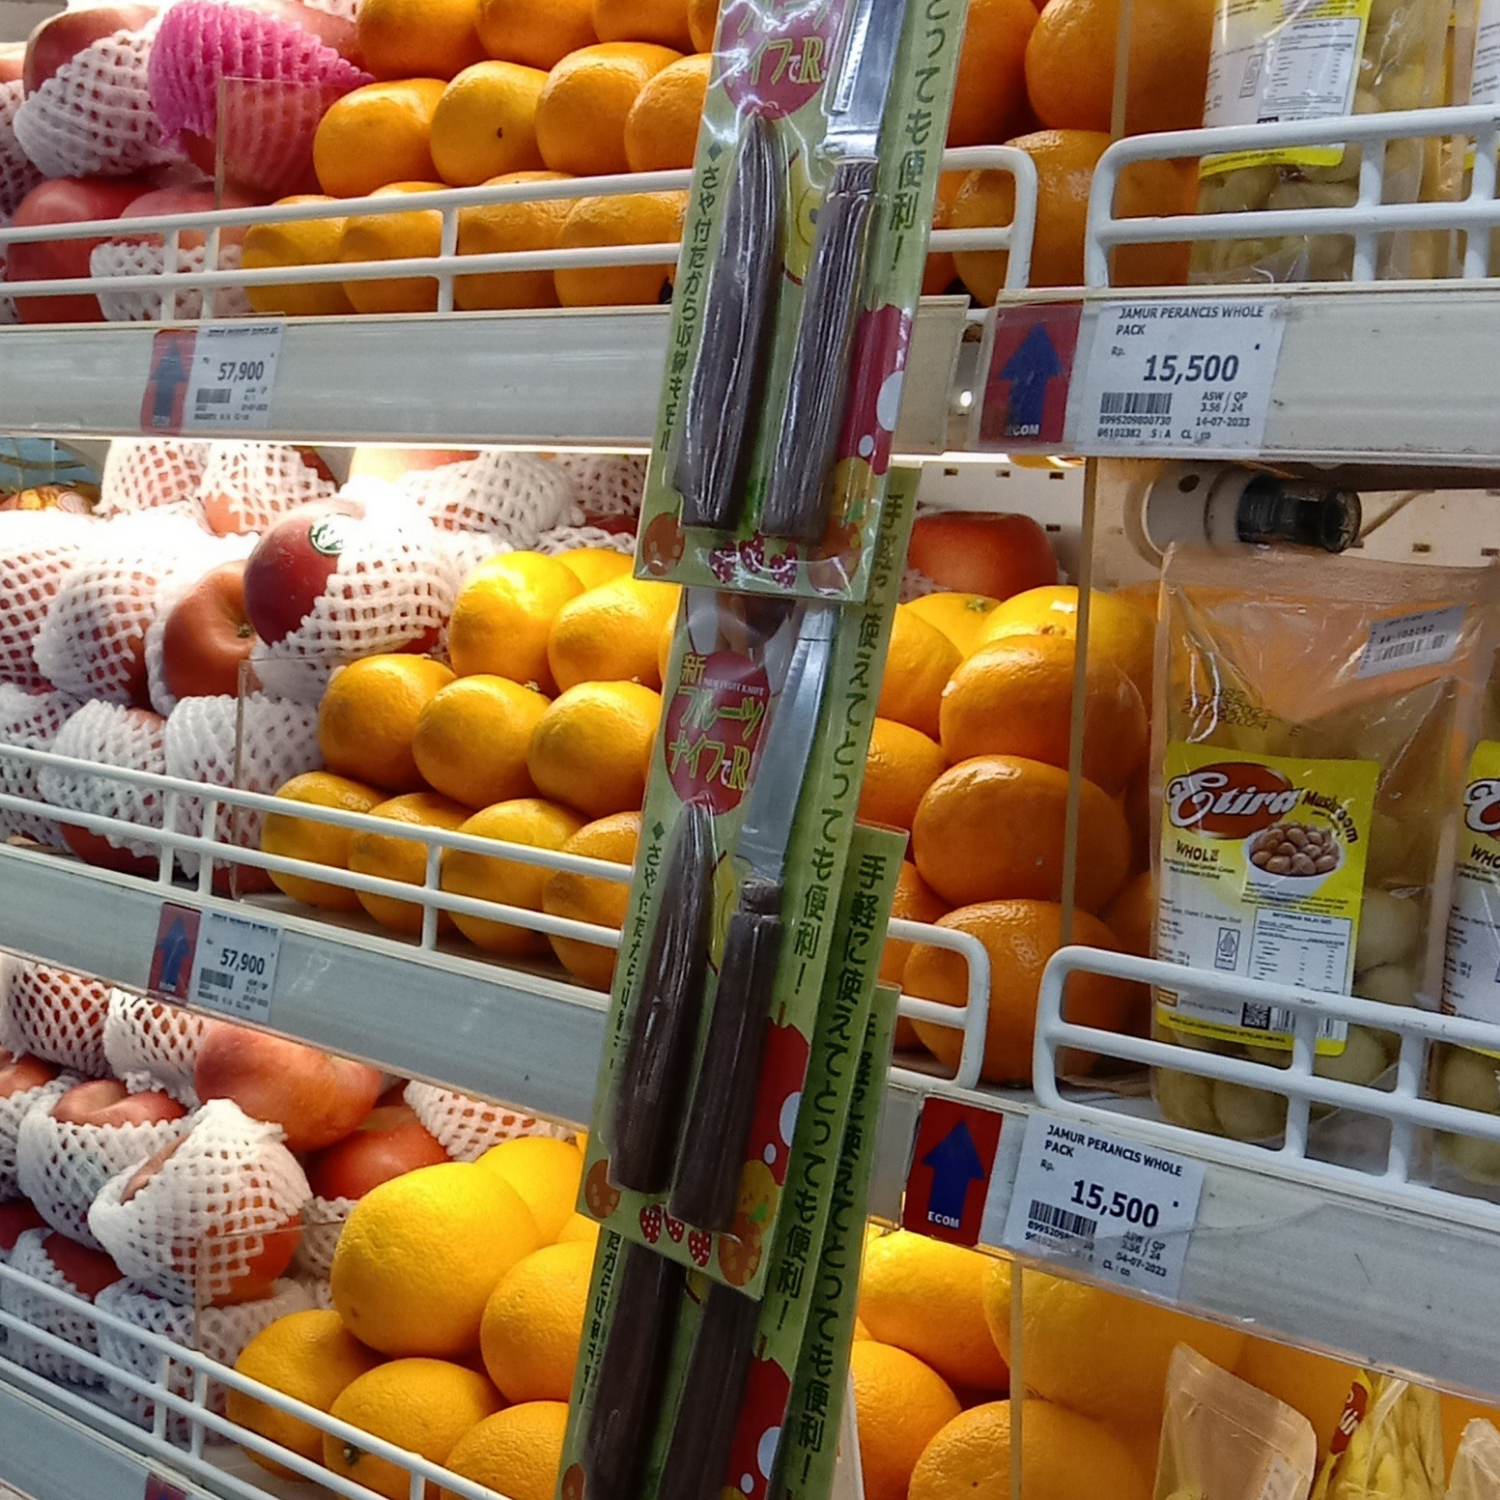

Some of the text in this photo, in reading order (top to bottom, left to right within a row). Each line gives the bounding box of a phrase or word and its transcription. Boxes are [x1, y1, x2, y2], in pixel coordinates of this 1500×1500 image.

[1119, 304, 1265, 320] JAMUR PERANCIS WHOLE
[1116, 323, 1146, 336] PACK
[217, 360, 265, 383] 57,900
[1143, 354, 1240, 386] 15,500
[681, 652, 707, 684] 新
[1165, 771, 1304, 829] Etira
[1176, 840, 1220, 862] WHOLE
[220, 947, 266, 976] 57,900
[1044, 1139, 1075, 1158] PACK
[1047, 1124, 1184, 1178] JAMUR PERANCIS WHOLE
[1069, 1179, 1160, 1228] 15,500
[926, 1210, 961, 1229] ECOM
